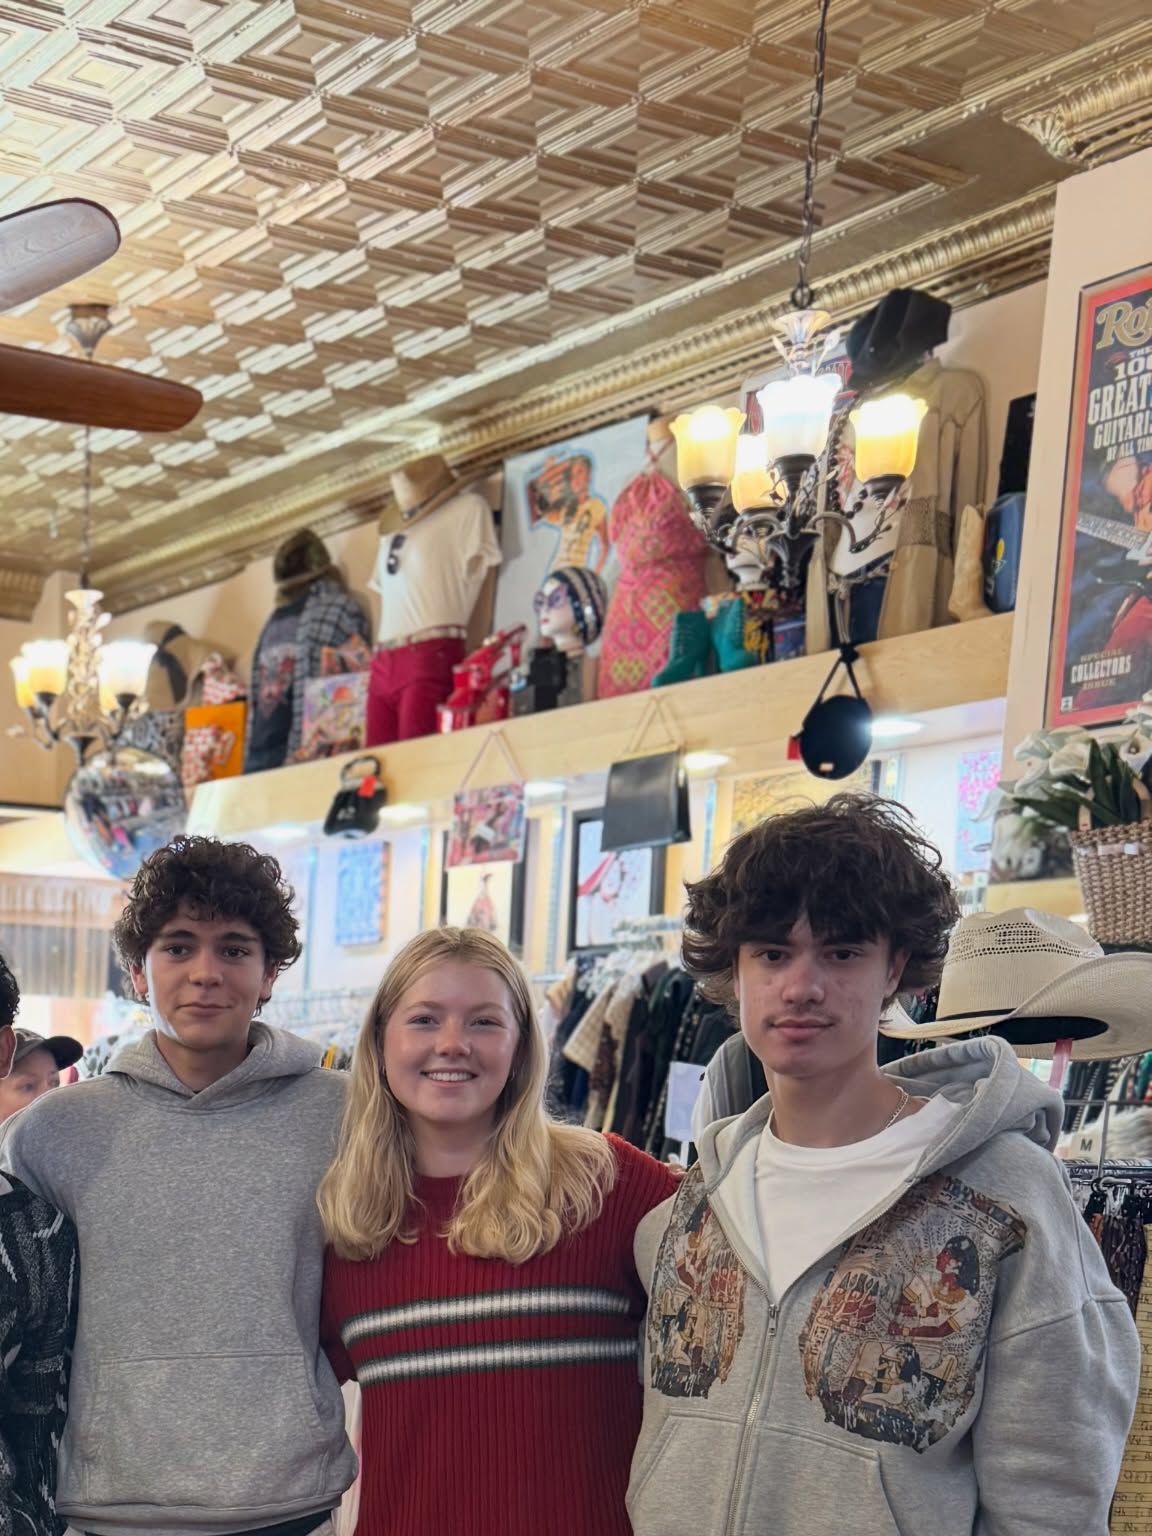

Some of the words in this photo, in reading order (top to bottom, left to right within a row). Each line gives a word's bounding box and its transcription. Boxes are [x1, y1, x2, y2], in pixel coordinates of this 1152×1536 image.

[1088, 373, 1152, 426] GREAT
[1071, 655, 1132, 684] COLLECTORS
[1080, 1138, 1093, 1151] M
